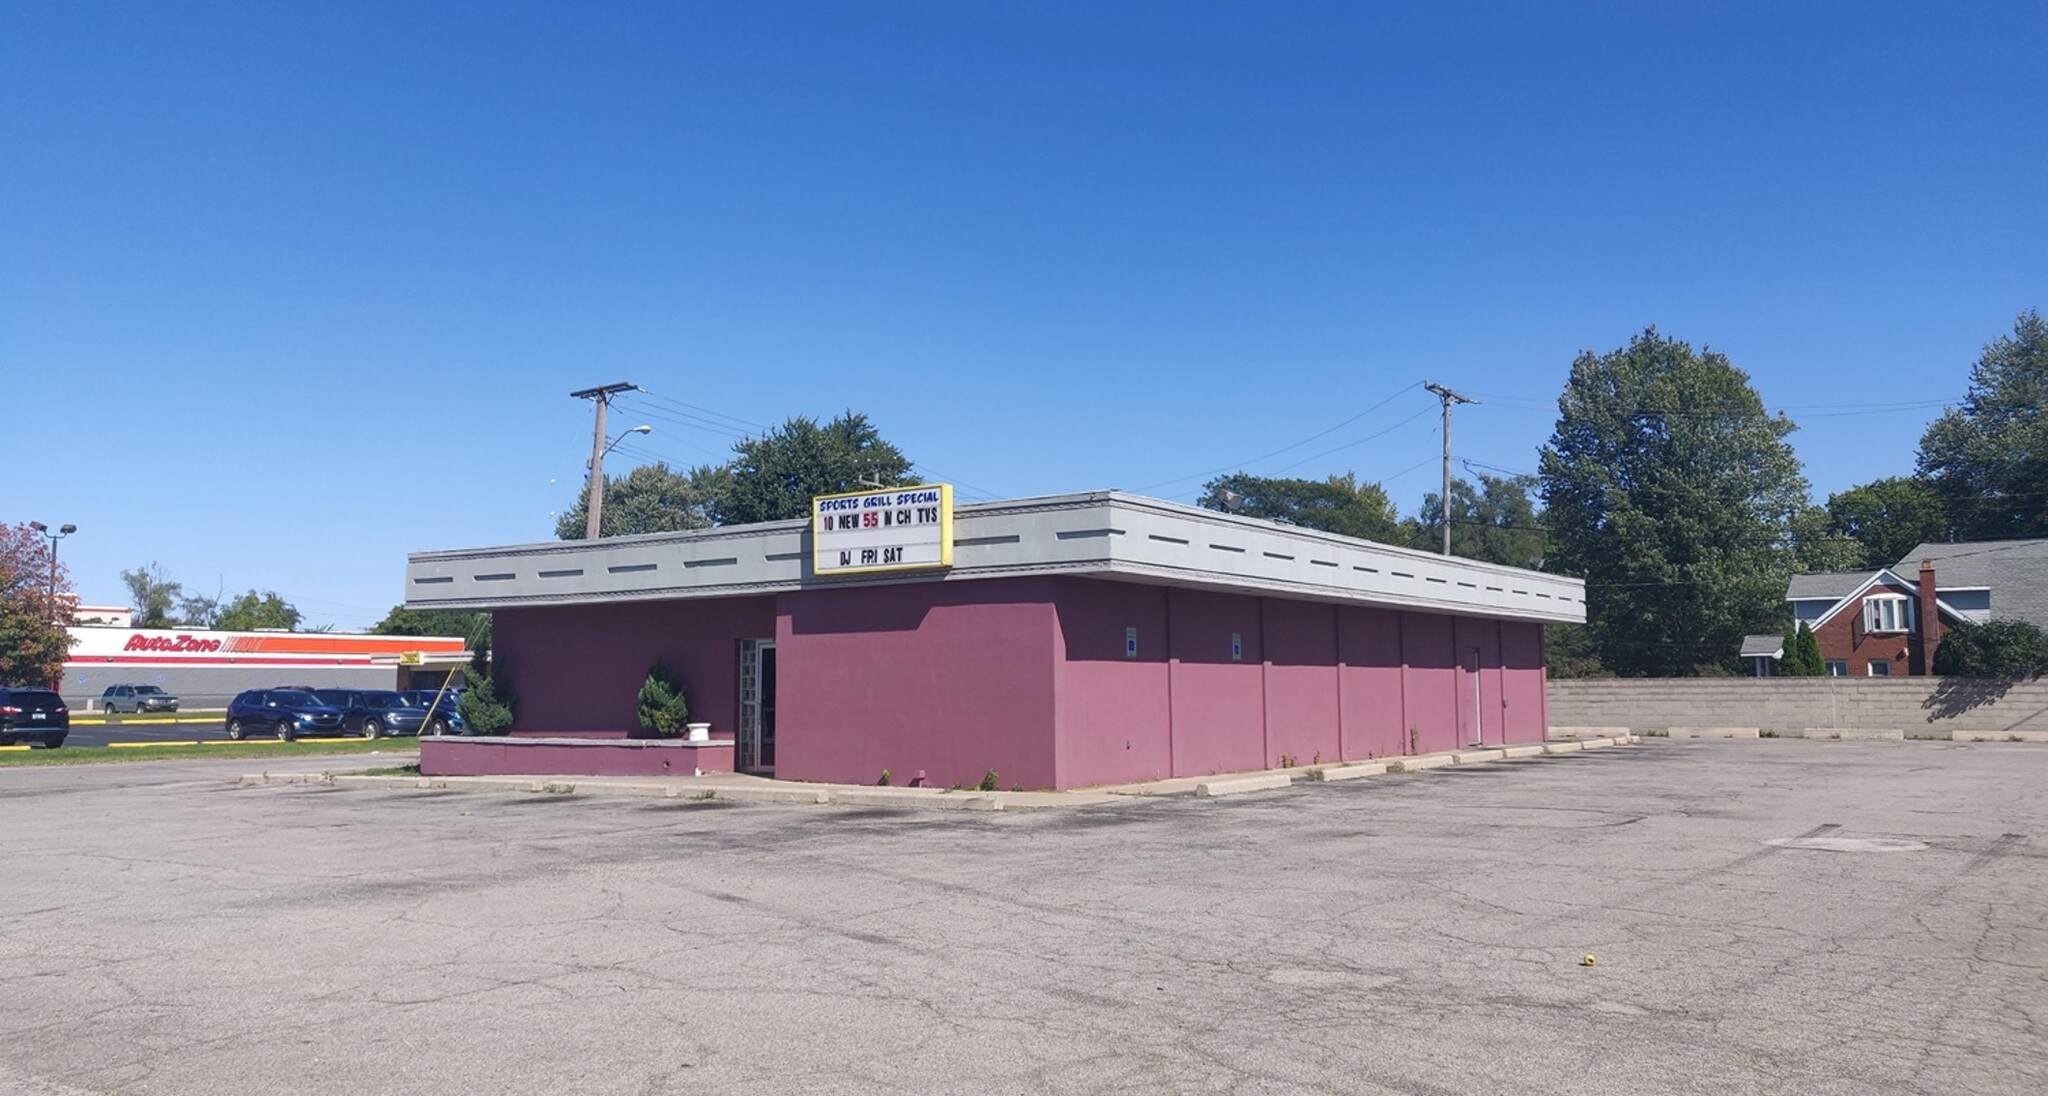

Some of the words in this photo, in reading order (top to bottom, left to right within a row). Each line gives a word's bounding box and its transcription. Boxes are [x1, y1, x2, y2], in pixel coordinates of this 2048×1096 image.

[820, 499, 859, 512] SPORTS
[864, 495, 892, 508] GRILL
[897, 491, 939, 505] SPECIAL
[823, 516, 833, 530] 10
[838, 514, 859, 529] NEW
[863, 511, 878, 527] 55
[896, 509, 911, 525] CH
[917, 507, 938, 523] TVS
[840, 551, 851, 566] DJ
[861, 549, 877, 564] FRI
[883, 547, 903, 563] SAT
[124, 634, 221, 652] AutoZone
